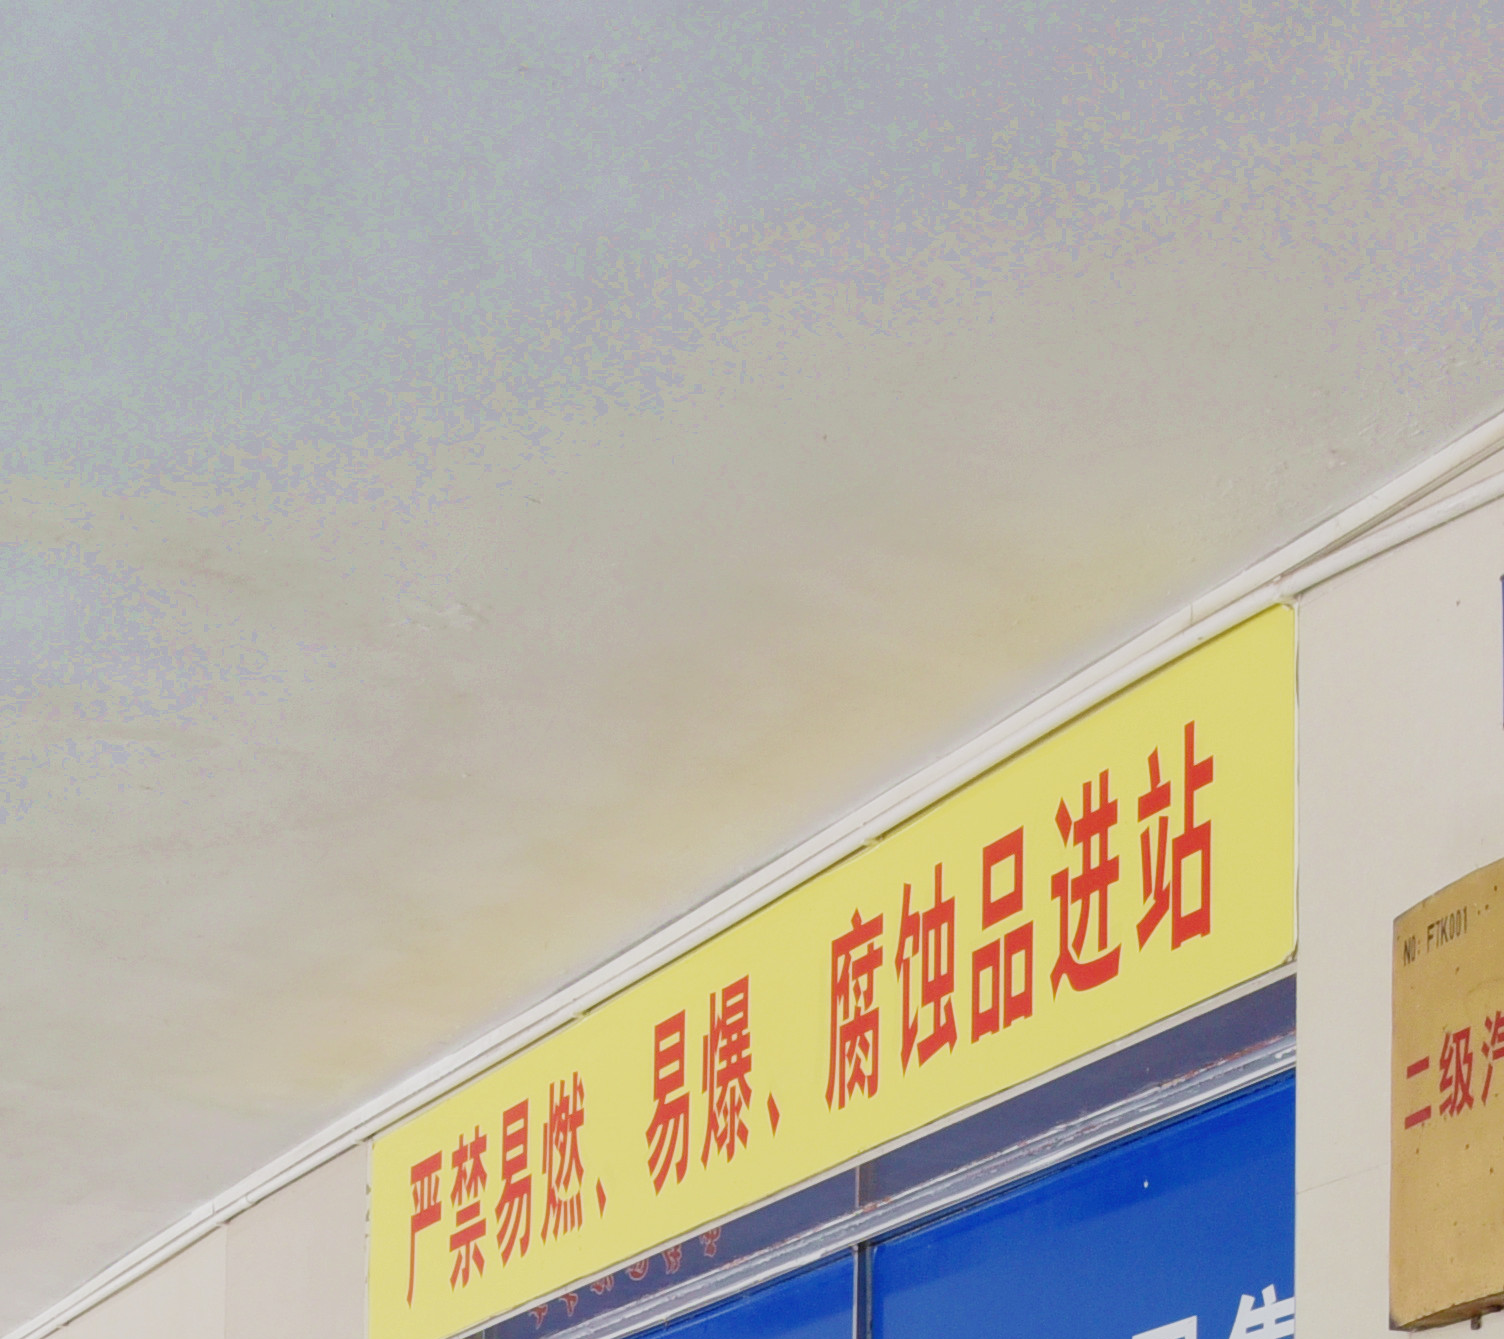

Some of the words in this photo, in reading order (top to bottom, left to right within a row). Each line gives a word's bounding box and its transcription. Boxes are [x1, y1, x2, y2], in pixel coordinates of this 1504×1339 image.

[405, 720, 1215, 1310] 严禁易燃、易爆、腐蚀品进站
